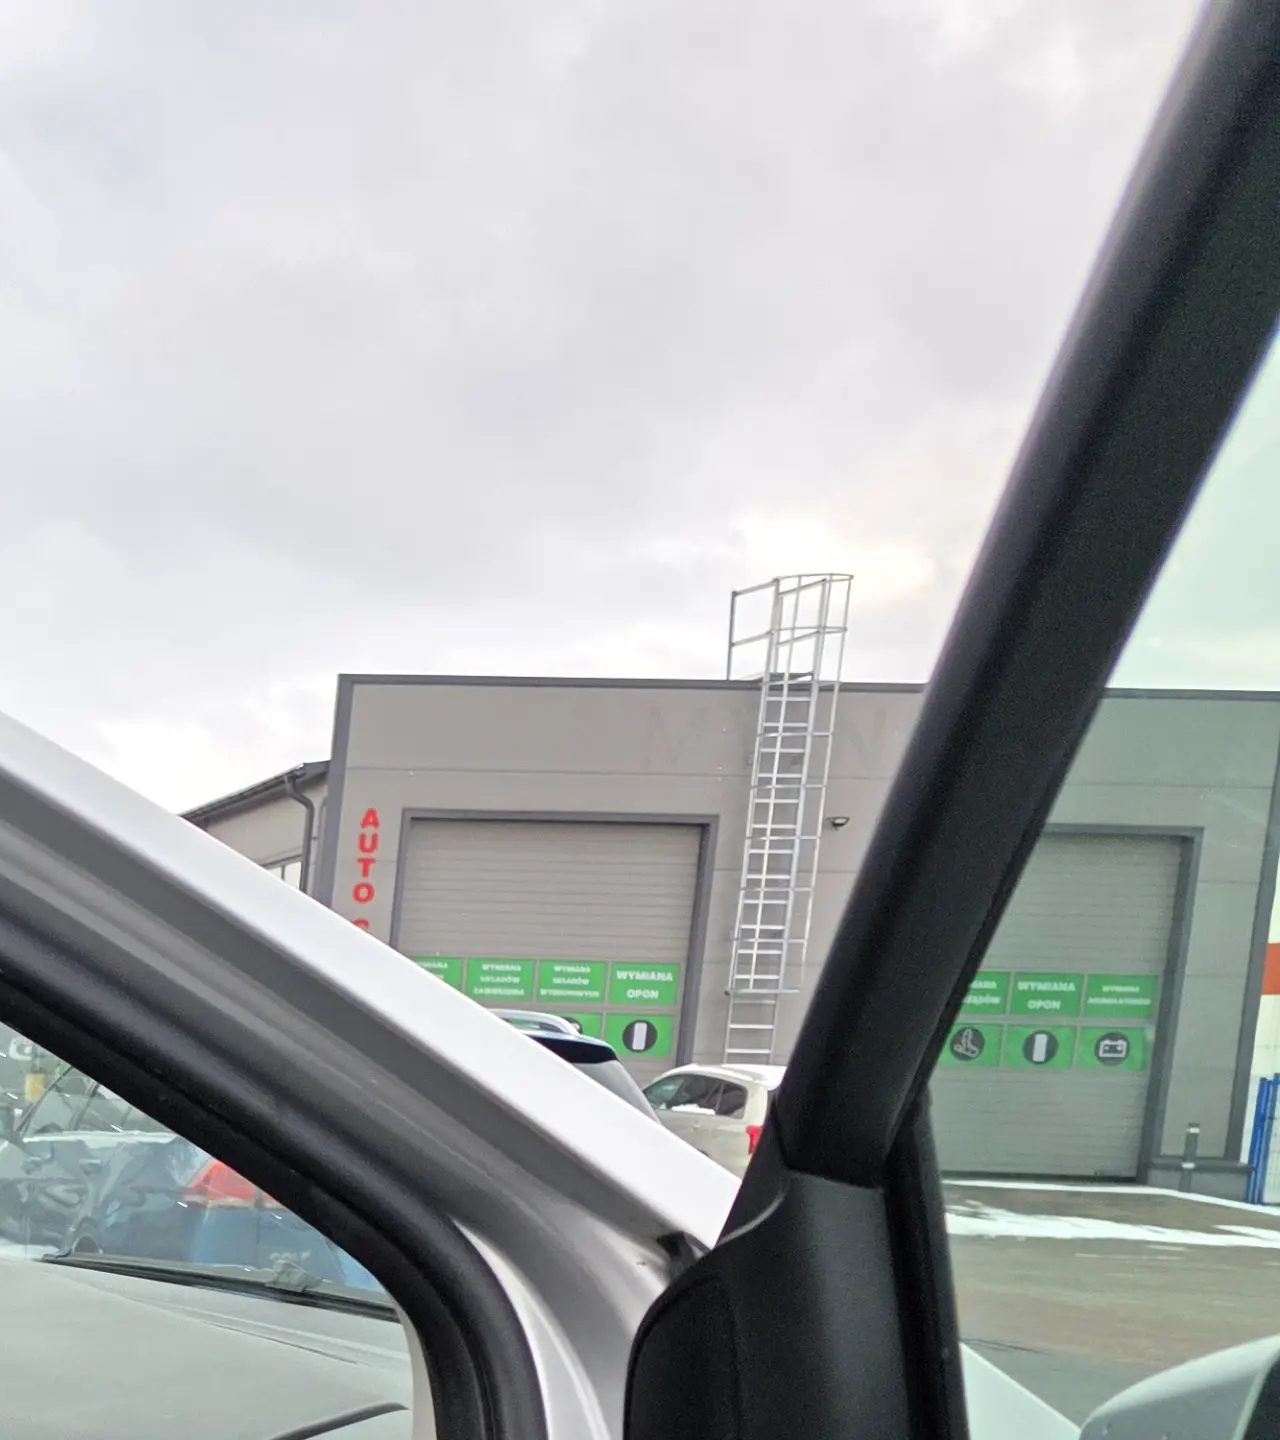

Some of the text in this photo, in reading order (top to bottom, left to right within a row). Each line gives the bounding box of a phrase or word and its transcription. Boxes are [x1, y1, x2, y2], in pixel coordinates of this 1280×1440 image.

[352, 807, 380, 904] AUTO
[616, 970, 673, 981] WYMIANA
[1017, 980, 1076, 992] WYMIANA
[626, 988, 659, 999] OPON
[1027, 1000, 1061, 1010] OPON
